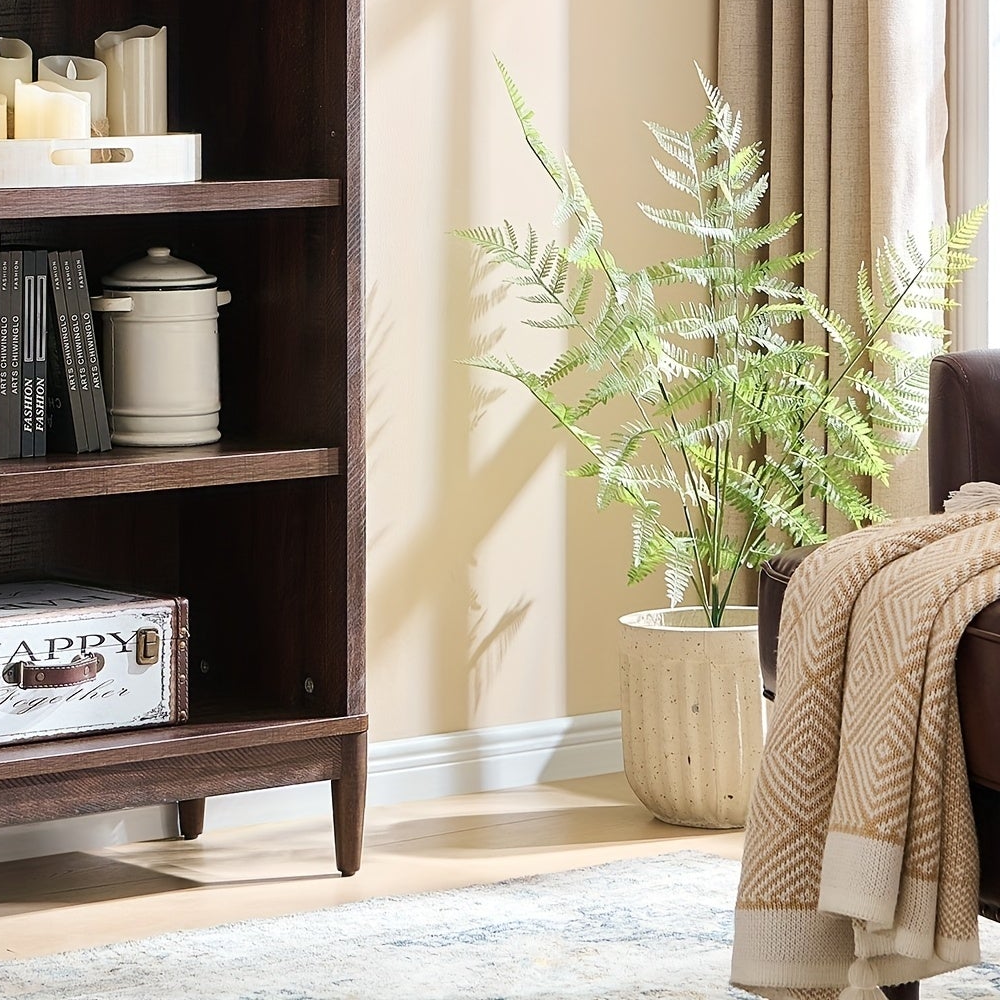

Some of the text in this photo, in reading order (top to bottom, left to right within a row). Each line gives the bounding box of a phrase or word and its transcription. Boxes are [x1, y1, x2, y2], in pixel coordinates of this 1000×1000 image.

[52, 261, 60, 290] FASHION
[64, 260, 72, 290] FASHION
[76, 259, 84, 289] FASHION
[11, 370, 19, 395] ARTS
[67, 367, 76, 391] ARTS
[79, 367, 88, 391] ARTS
[91, 365, 101, 389] ARTS
[23, 377, 33, 433] FASHION
[35, 376, 45, 432] FASHION
